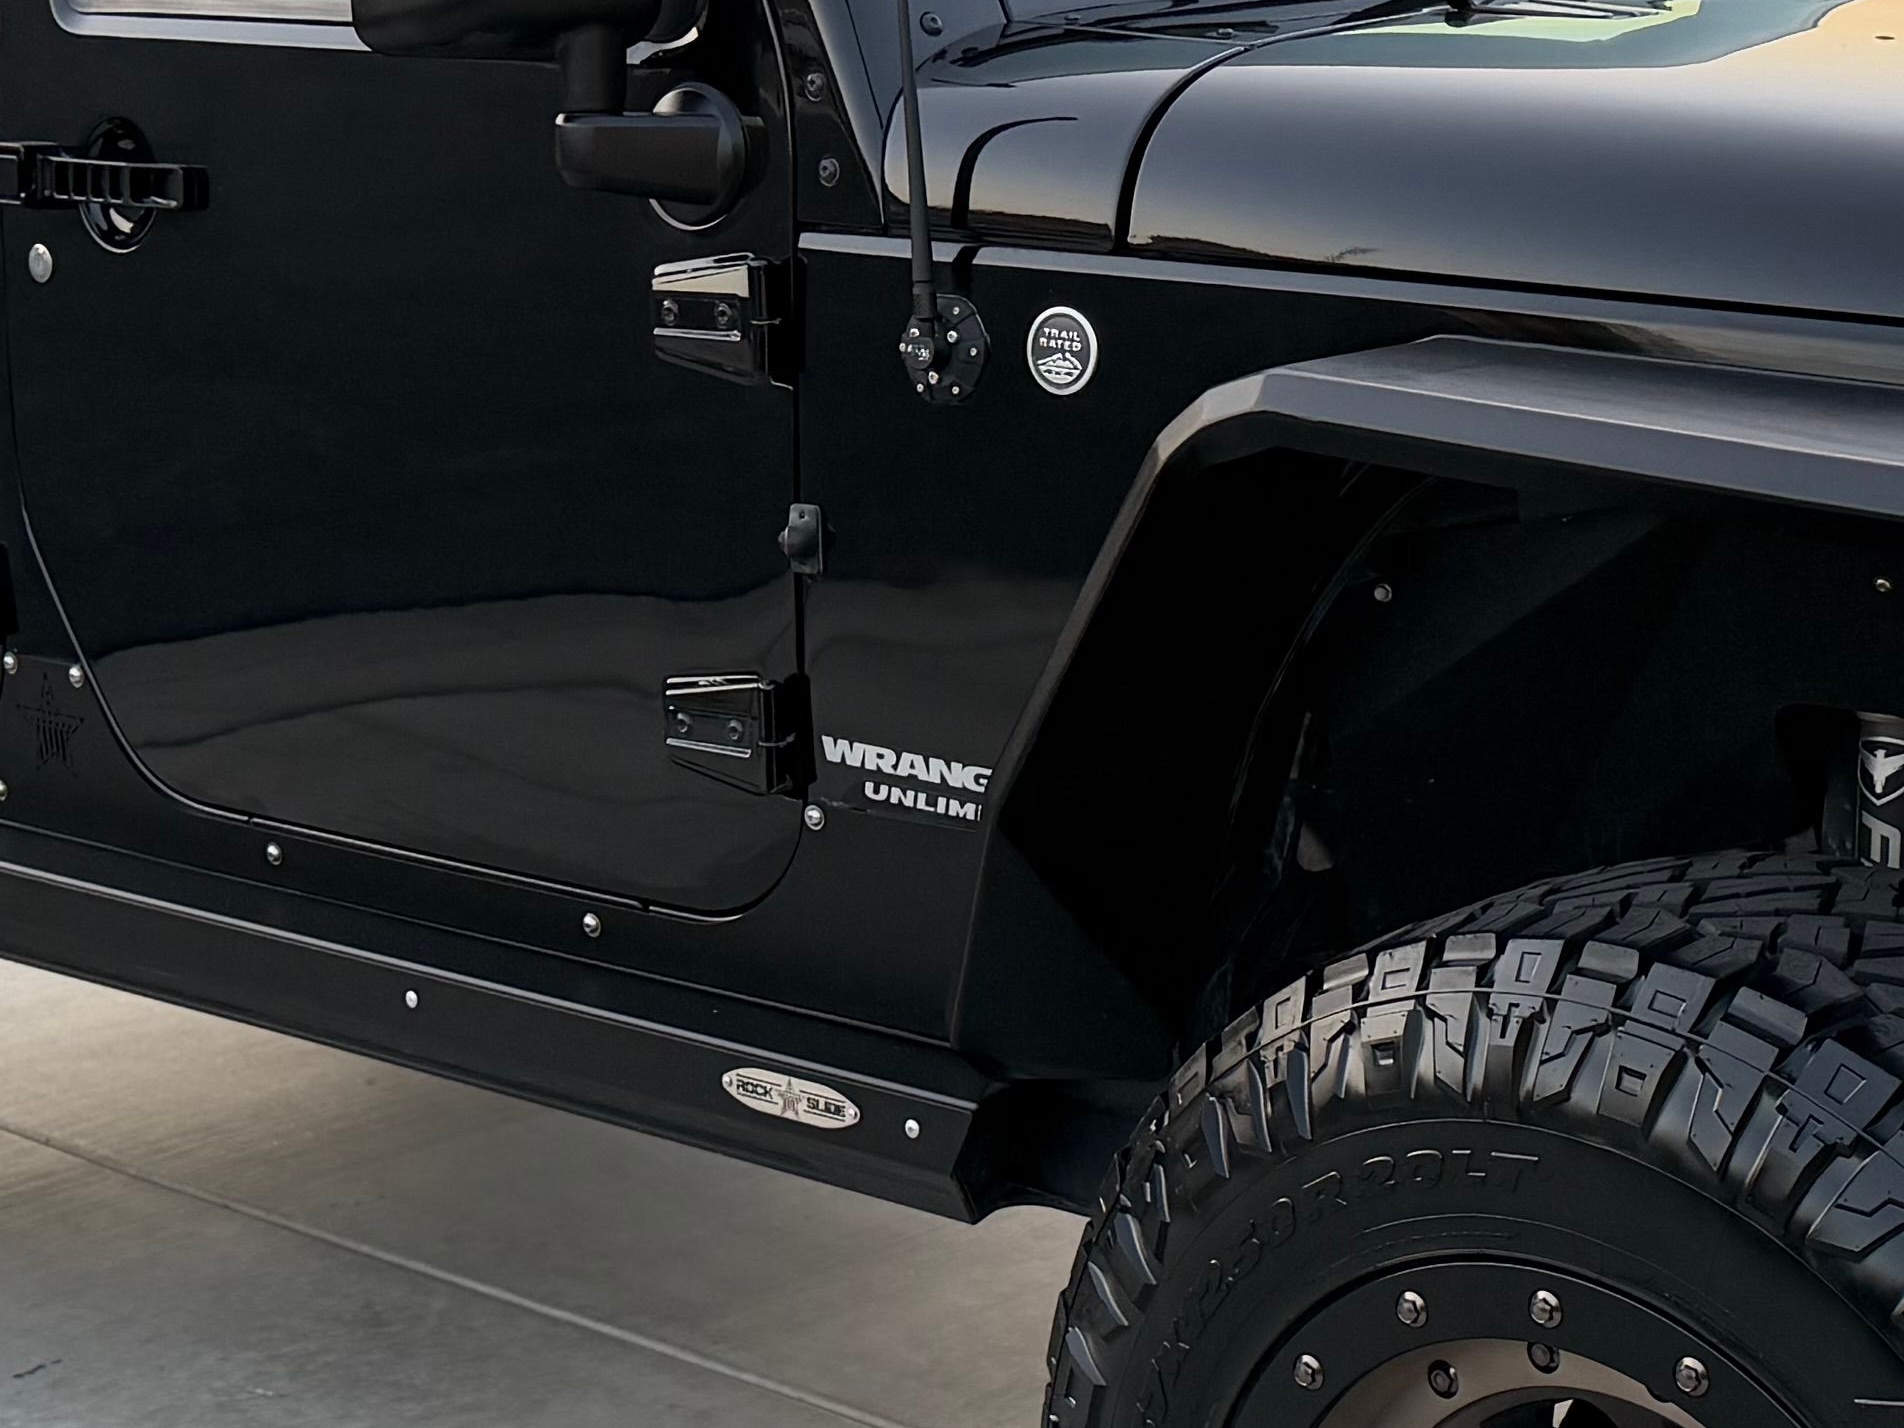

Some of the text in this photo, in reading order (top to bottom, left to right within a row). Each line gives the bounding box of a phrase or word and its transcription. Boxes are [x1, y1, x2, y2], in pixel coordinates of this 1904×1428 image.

[1042, 327, 1081, 341] TRAIL
[1039, 336, 1082, 351] RATED
[736, 1078, 847, 1118] ROCK SLIDE
